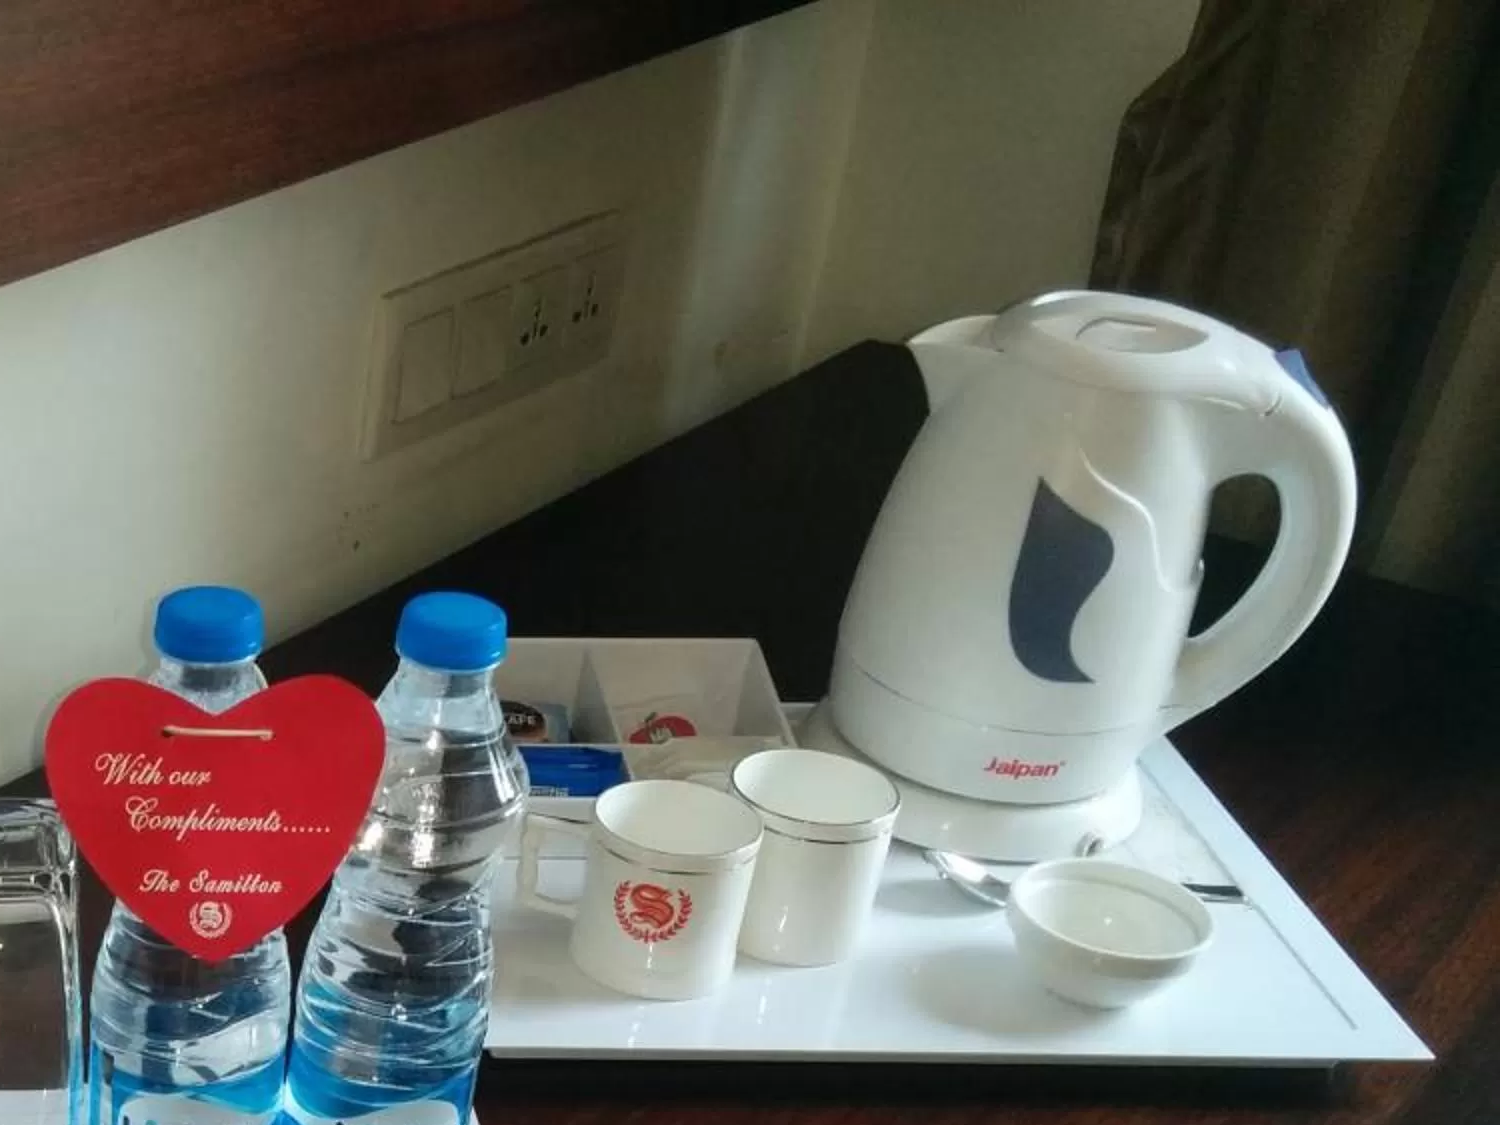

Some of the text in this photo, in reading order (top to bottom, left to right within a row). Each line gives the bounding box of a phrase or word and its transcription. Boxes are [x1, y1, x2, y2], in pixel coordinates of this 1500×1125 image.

[95, 753, 212, 786] With our
[983, 757, 1060, 780] Jaipan
[139, 869, 180, 893] The
